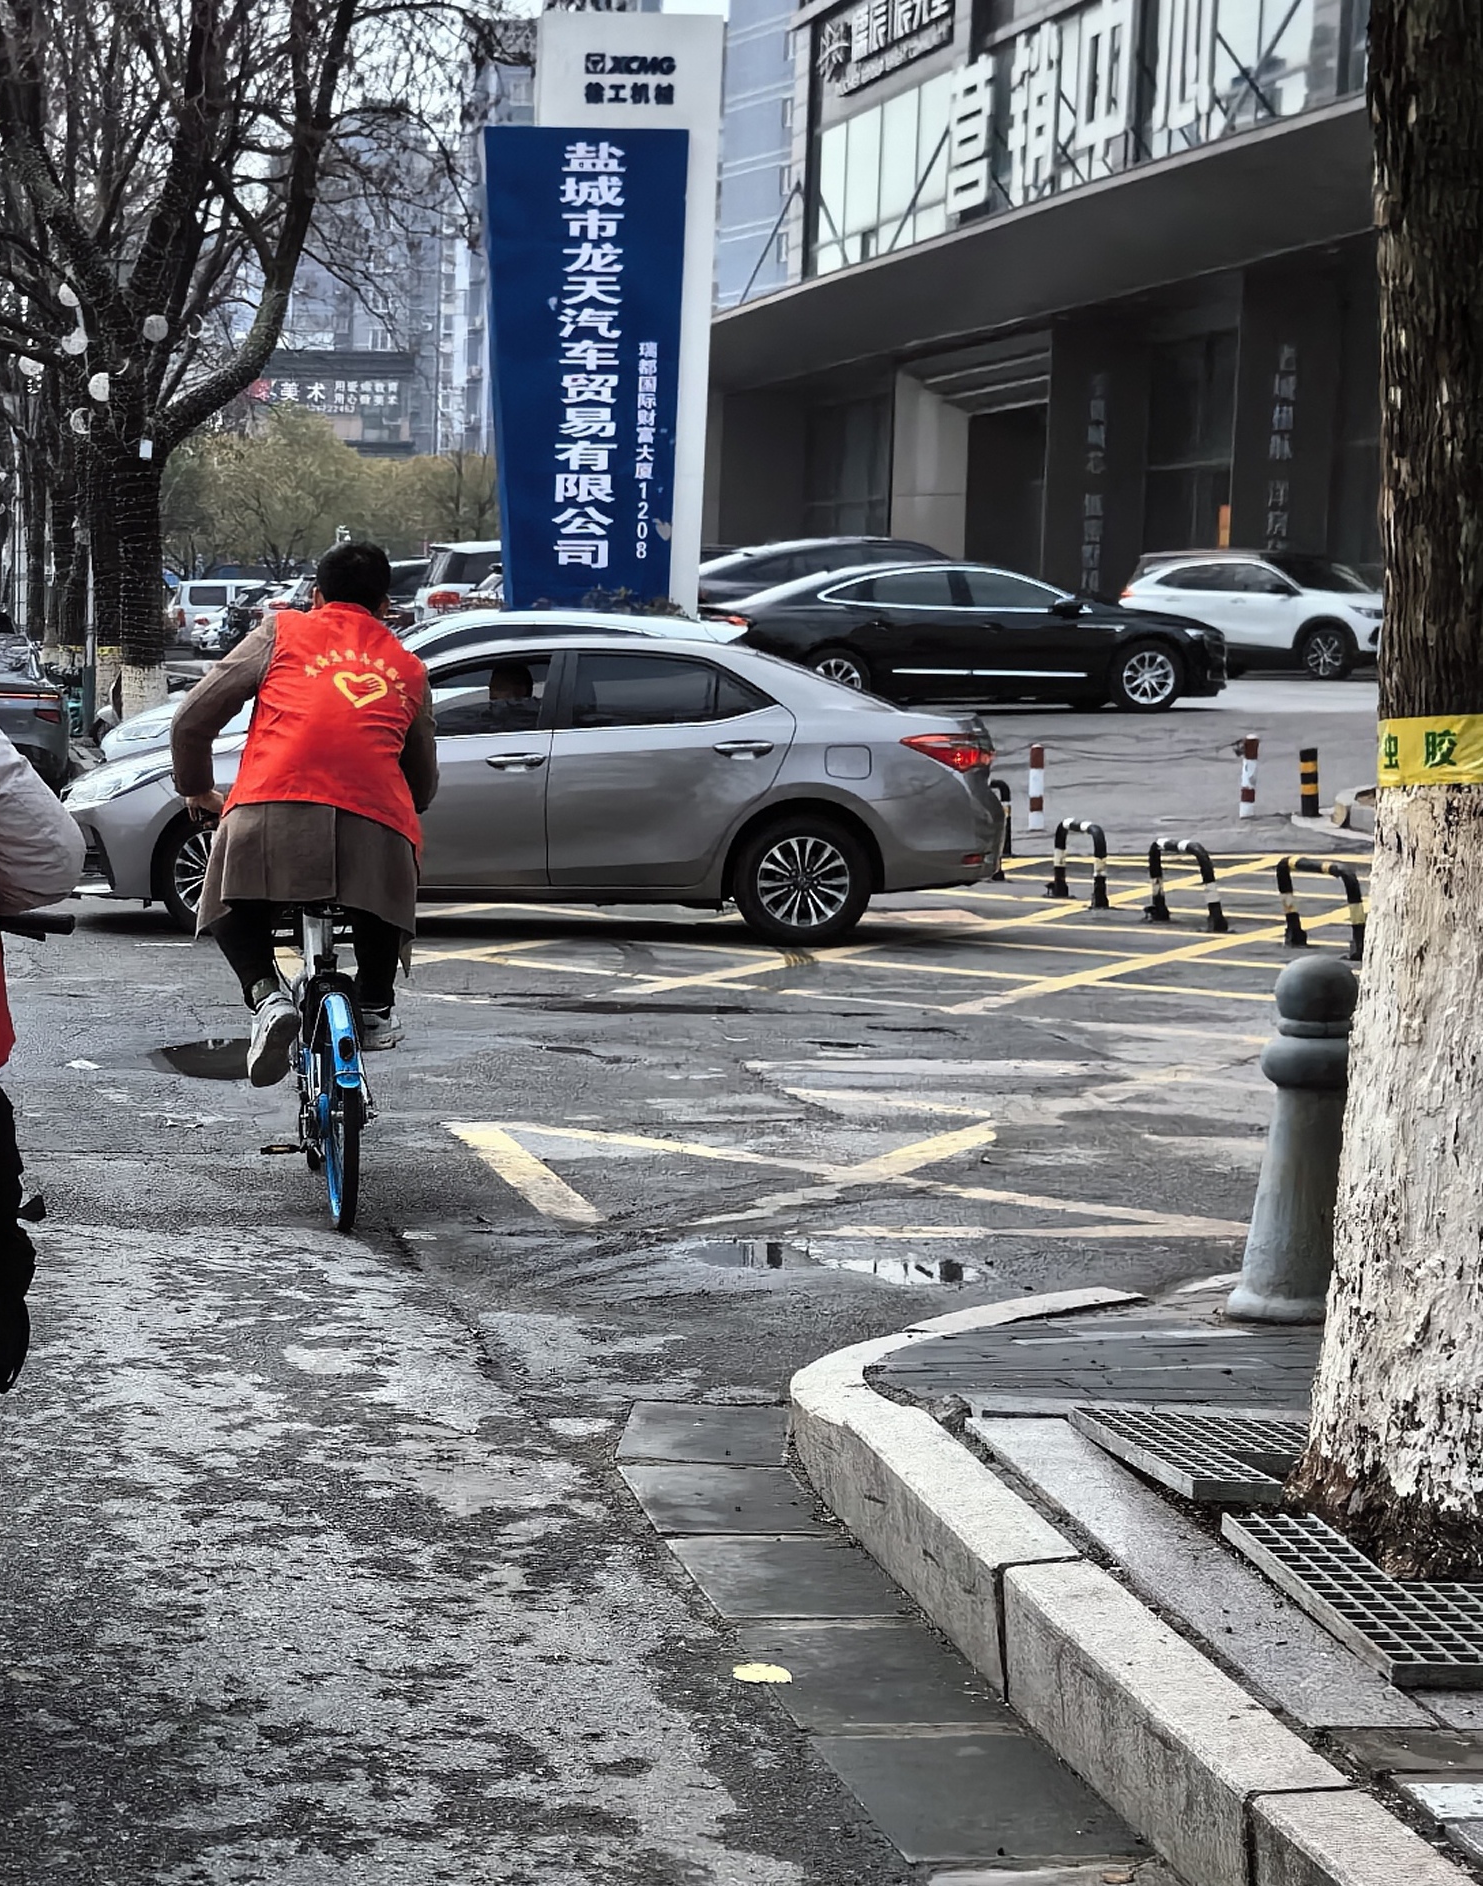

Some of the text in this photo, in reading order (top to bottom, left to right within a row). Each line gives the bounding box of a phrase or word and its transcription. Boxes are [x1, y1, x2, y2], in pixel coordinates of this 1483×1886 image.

[606, 55, 676, 76] XCMG
[280, 381, 327, 403] 美术
[551, 141, 627, 569] 盐城市龙天汽车贸易有限公司
[633, 341, 659, 560] 瑞都国际财富大厦1208
